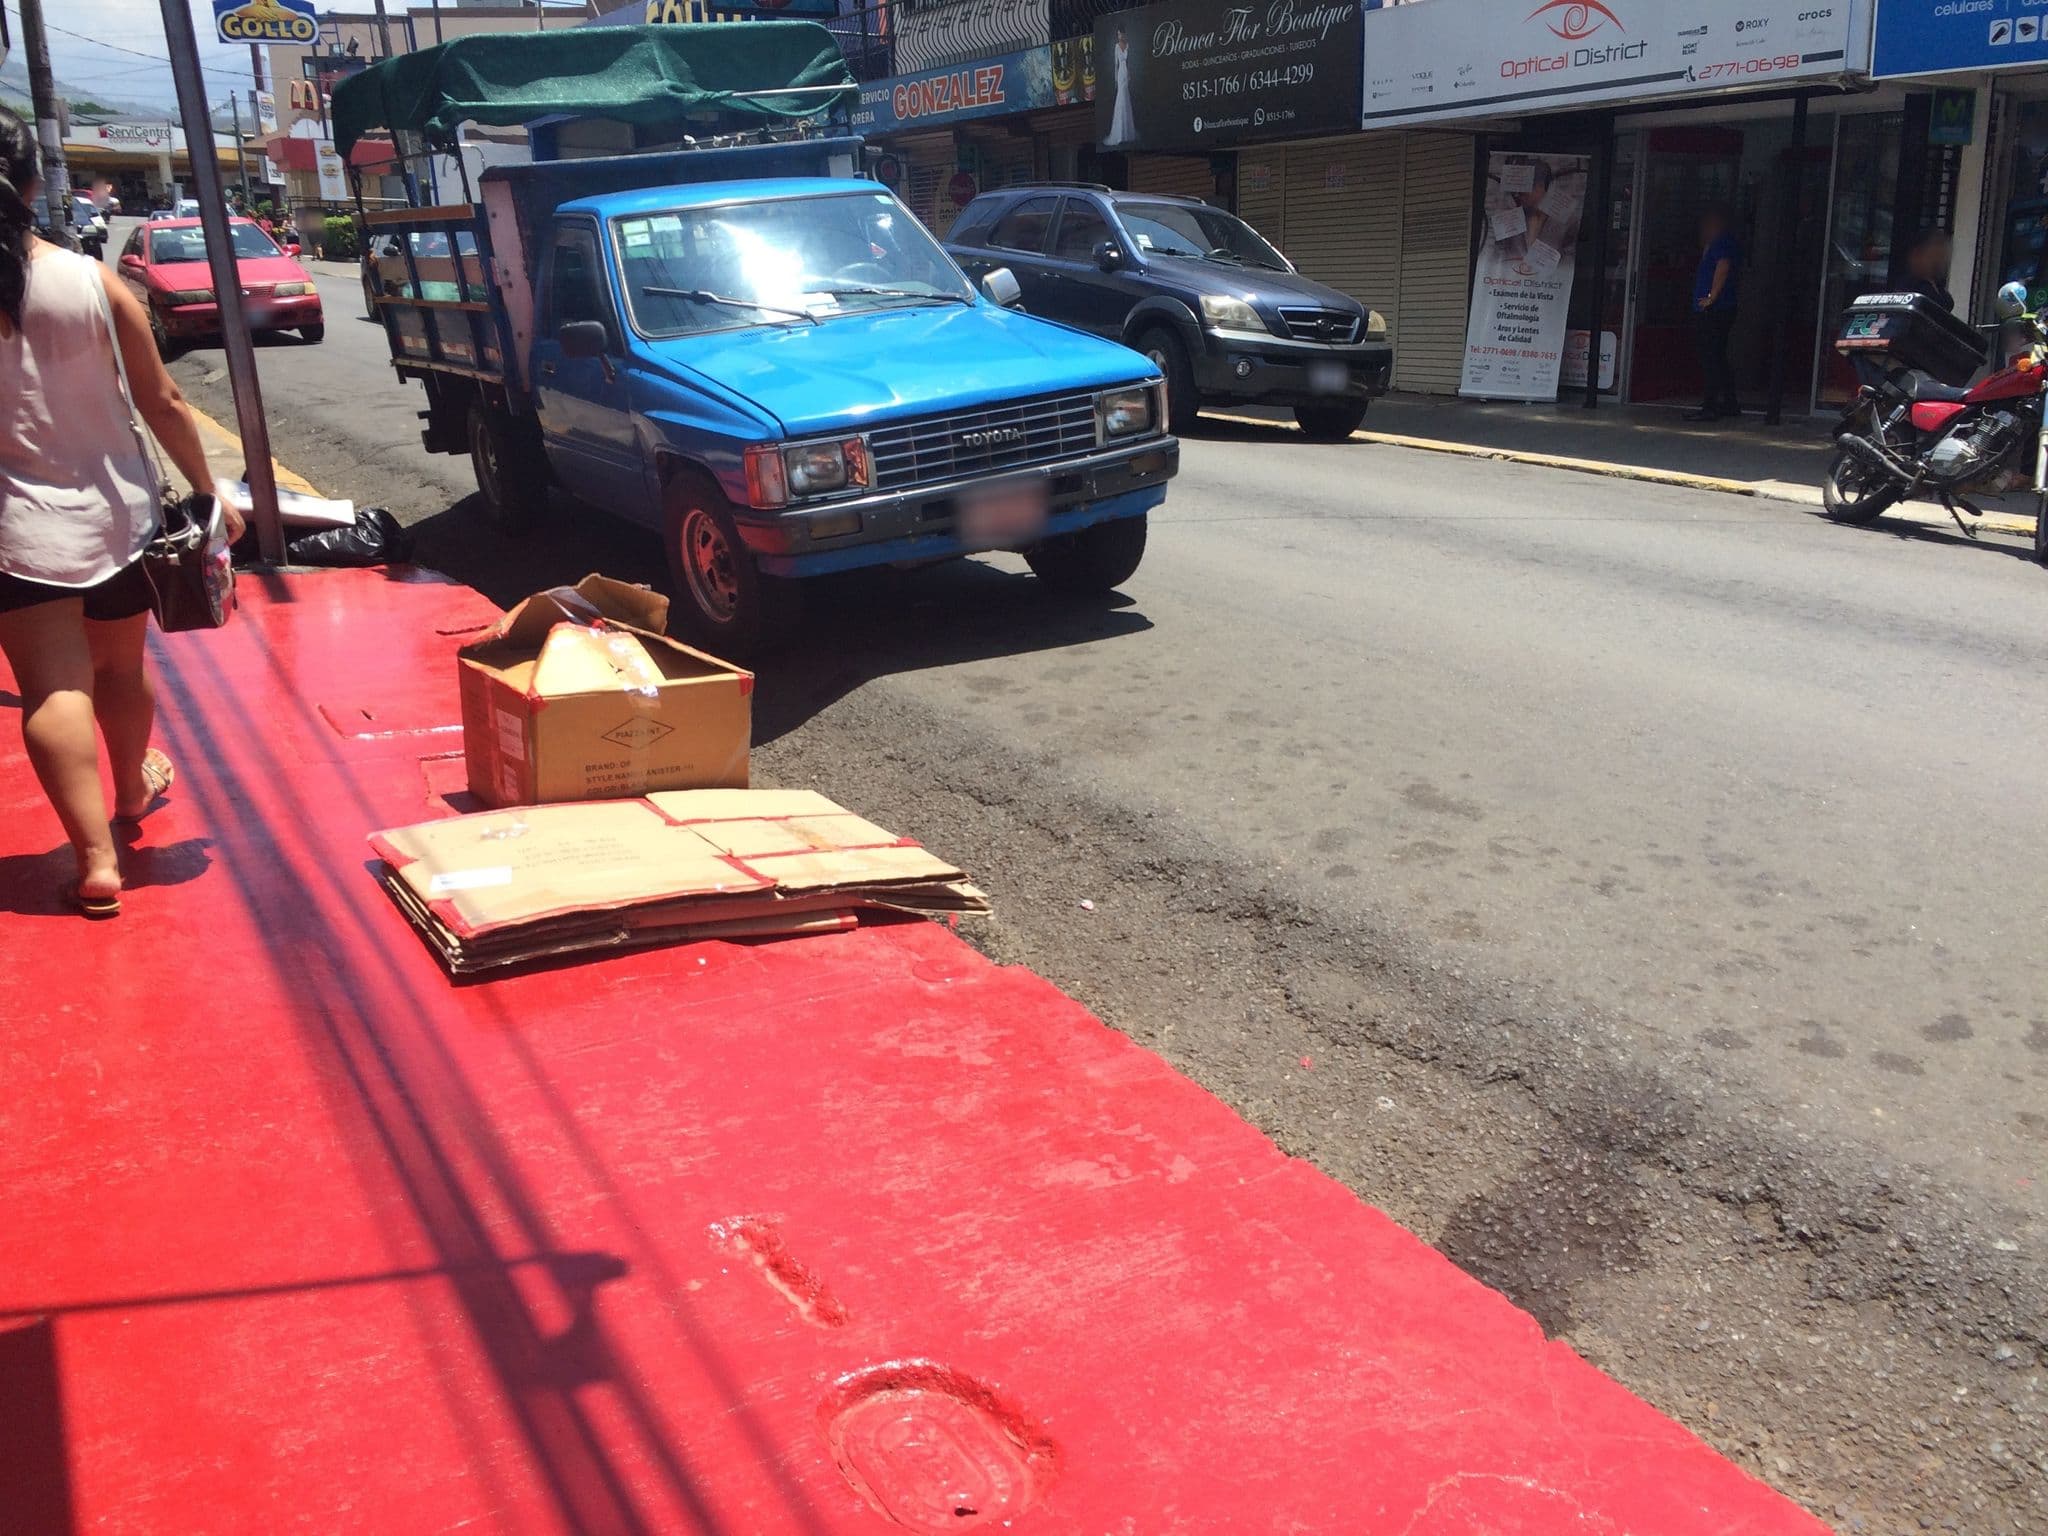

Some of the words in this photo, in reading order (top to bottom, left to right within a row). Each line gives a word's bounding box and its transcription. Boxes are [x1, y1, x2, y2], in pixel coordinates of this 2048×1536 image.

[1798, 8, 1832, 21] crocs
[1934, 0, 1994, 17] celulares
[224, 16, 312, 38] GOLLO
[1152, 20, 1215, 57] Blanca
[1219, 6, 1261, 46] Flor
[1266, 0, 1354, 40] Boutique
[1745, 18, 1769, 30] ROXY
[1500, 52, 1569, 79] Optical
[1574, 40, 1648, 67] District
[1699, 54, 1799, 79] 2771-0698
[1182, 77, 1240, 100] 8515-1766
[1249, 63, 1314, 89] 6344-4299
[860, 89, 890, 104] ERVICIO
[893, 64, 1004, 120] GONZALEZ
[108, 126, 171, 137] ServiCentro
[1504, 303, 1529, 311] Servicio
[963, 428, 1021, 447] TOYOTA
[642, 765, 681, 776] ANISTER
